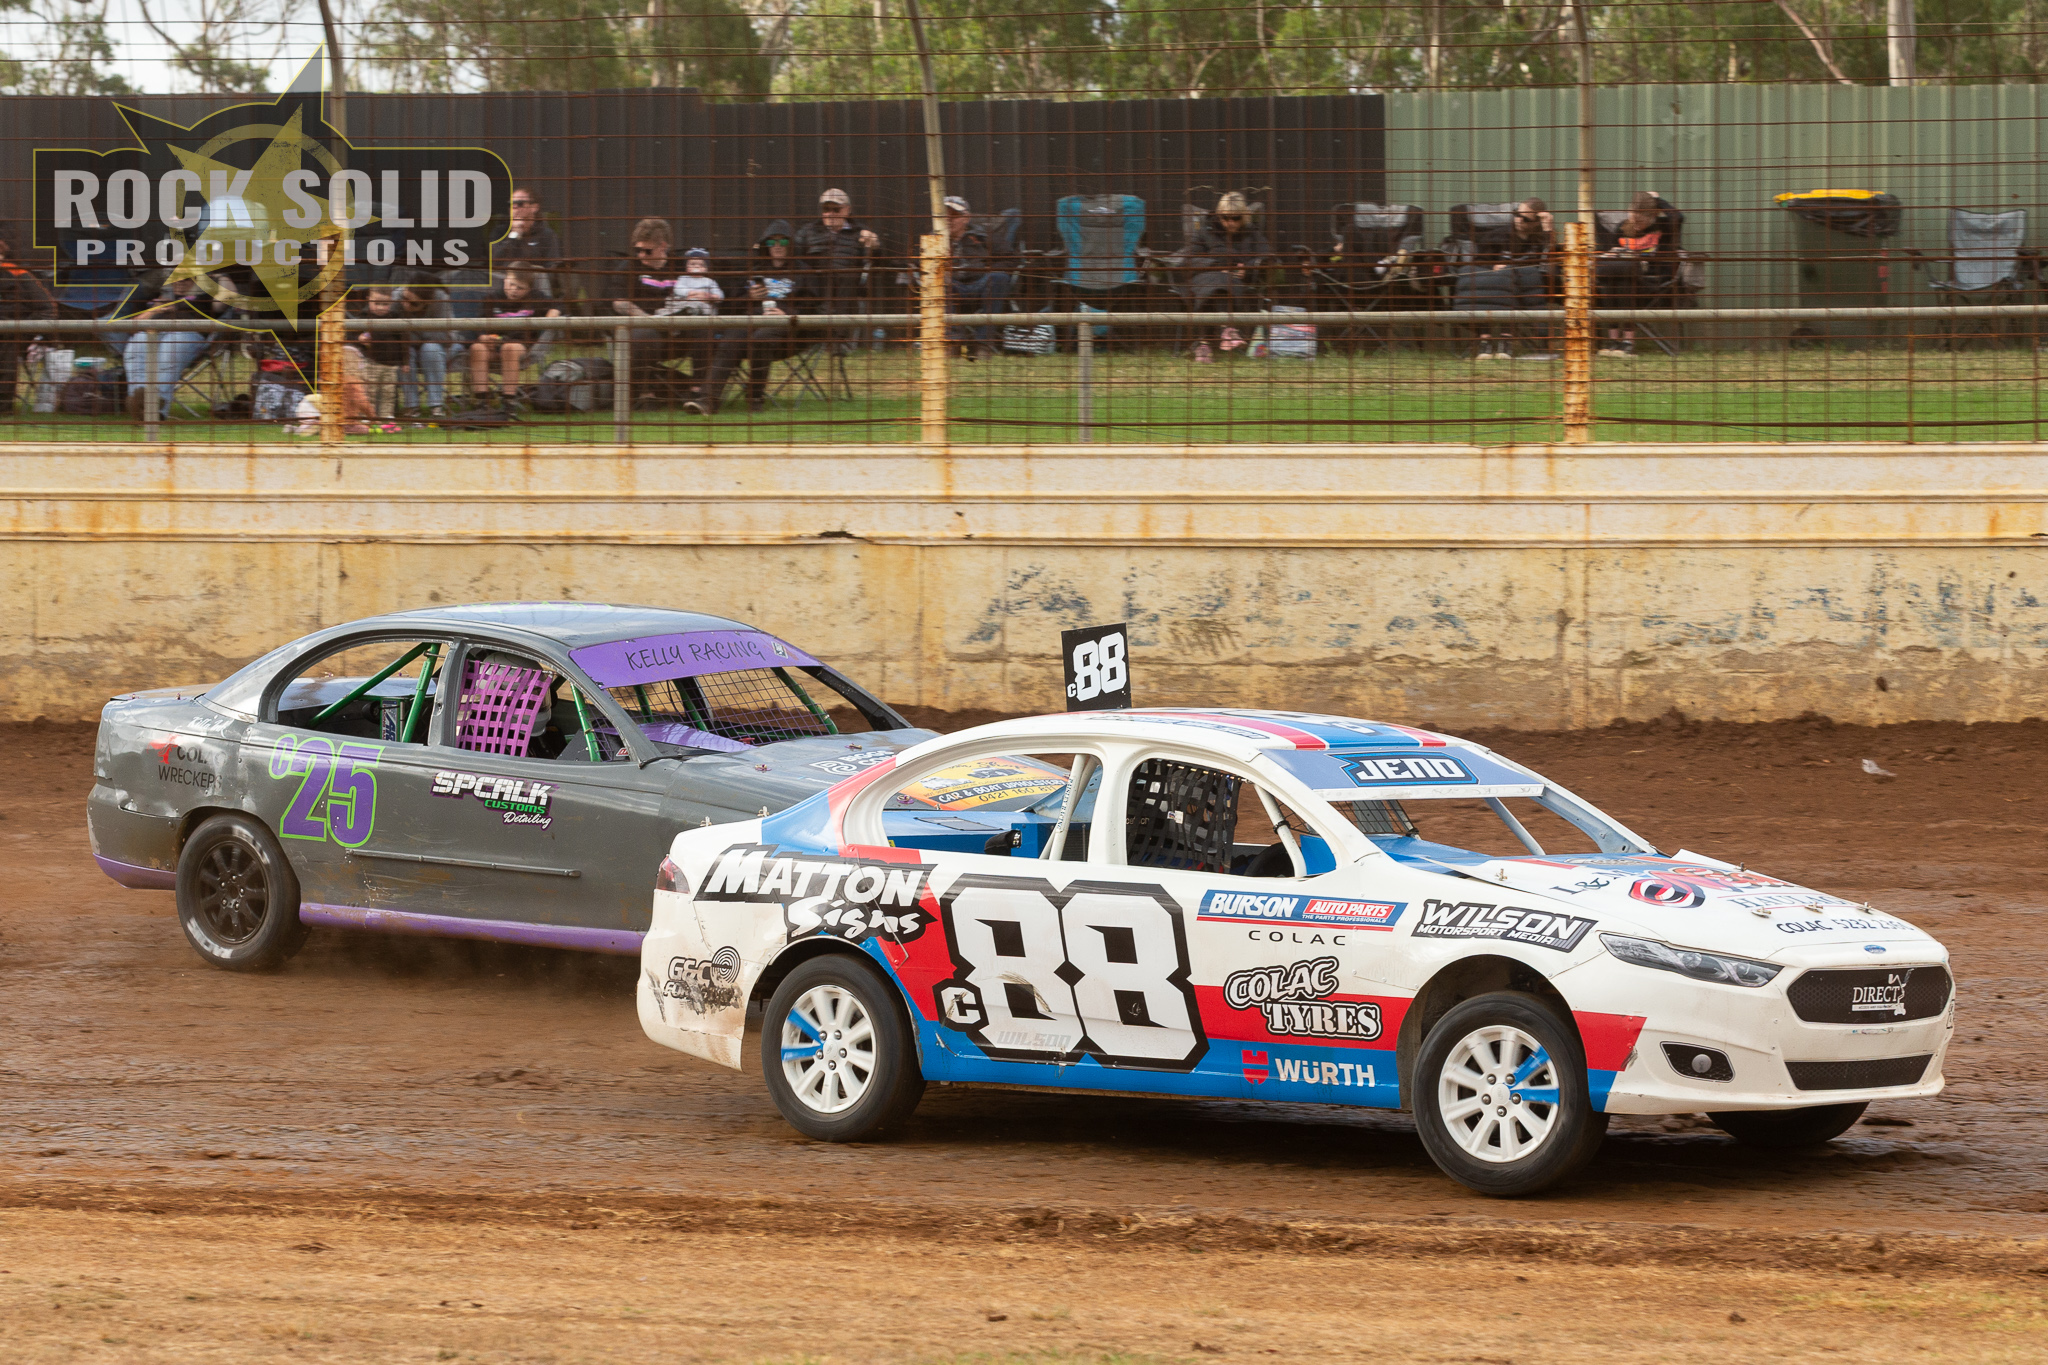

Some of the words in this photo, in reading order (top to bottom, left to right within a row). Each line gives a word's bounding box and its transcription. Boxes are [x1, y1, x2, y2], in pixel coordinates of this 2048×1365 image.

[625, 645, 685, 671] KELLY
[688, 640, 767, 663] RACING
[1073, 631, 1127, 702] 88
[1356, 758, 1466, 780] JENO
[938, 791, 964, 803] CAR
[972, 783, 1003, 796] BOAT
[484, 799, 546, 814] CUSTOMS
[503, 811, 552, 829] Detailing
[704, 848, 924, 907] MATTON
[787, 895, 921, 939] Signs
[1209, 892, 1300, 918] BURSON
[1311, 900, 1347, 915] AUTO
[1347, 903, 1390, 917] PARTS
[1423, 902, 1583, 940] WILSON
[1776, 919, 1834, 934] COLAC
[1248, 929, 1346, 946] COLAC
[1417, 924, 1508, 937] MOTORSPORT
[1507, 929, 1555, 945] MEDIA
[950, 886, 1198, 1061] 88
[1227, 960, 1338, 1005] COLAC
[1852, 985, 1900, 1003] DIRECT
[1265, 1001, 1379, 1036] TYRES
